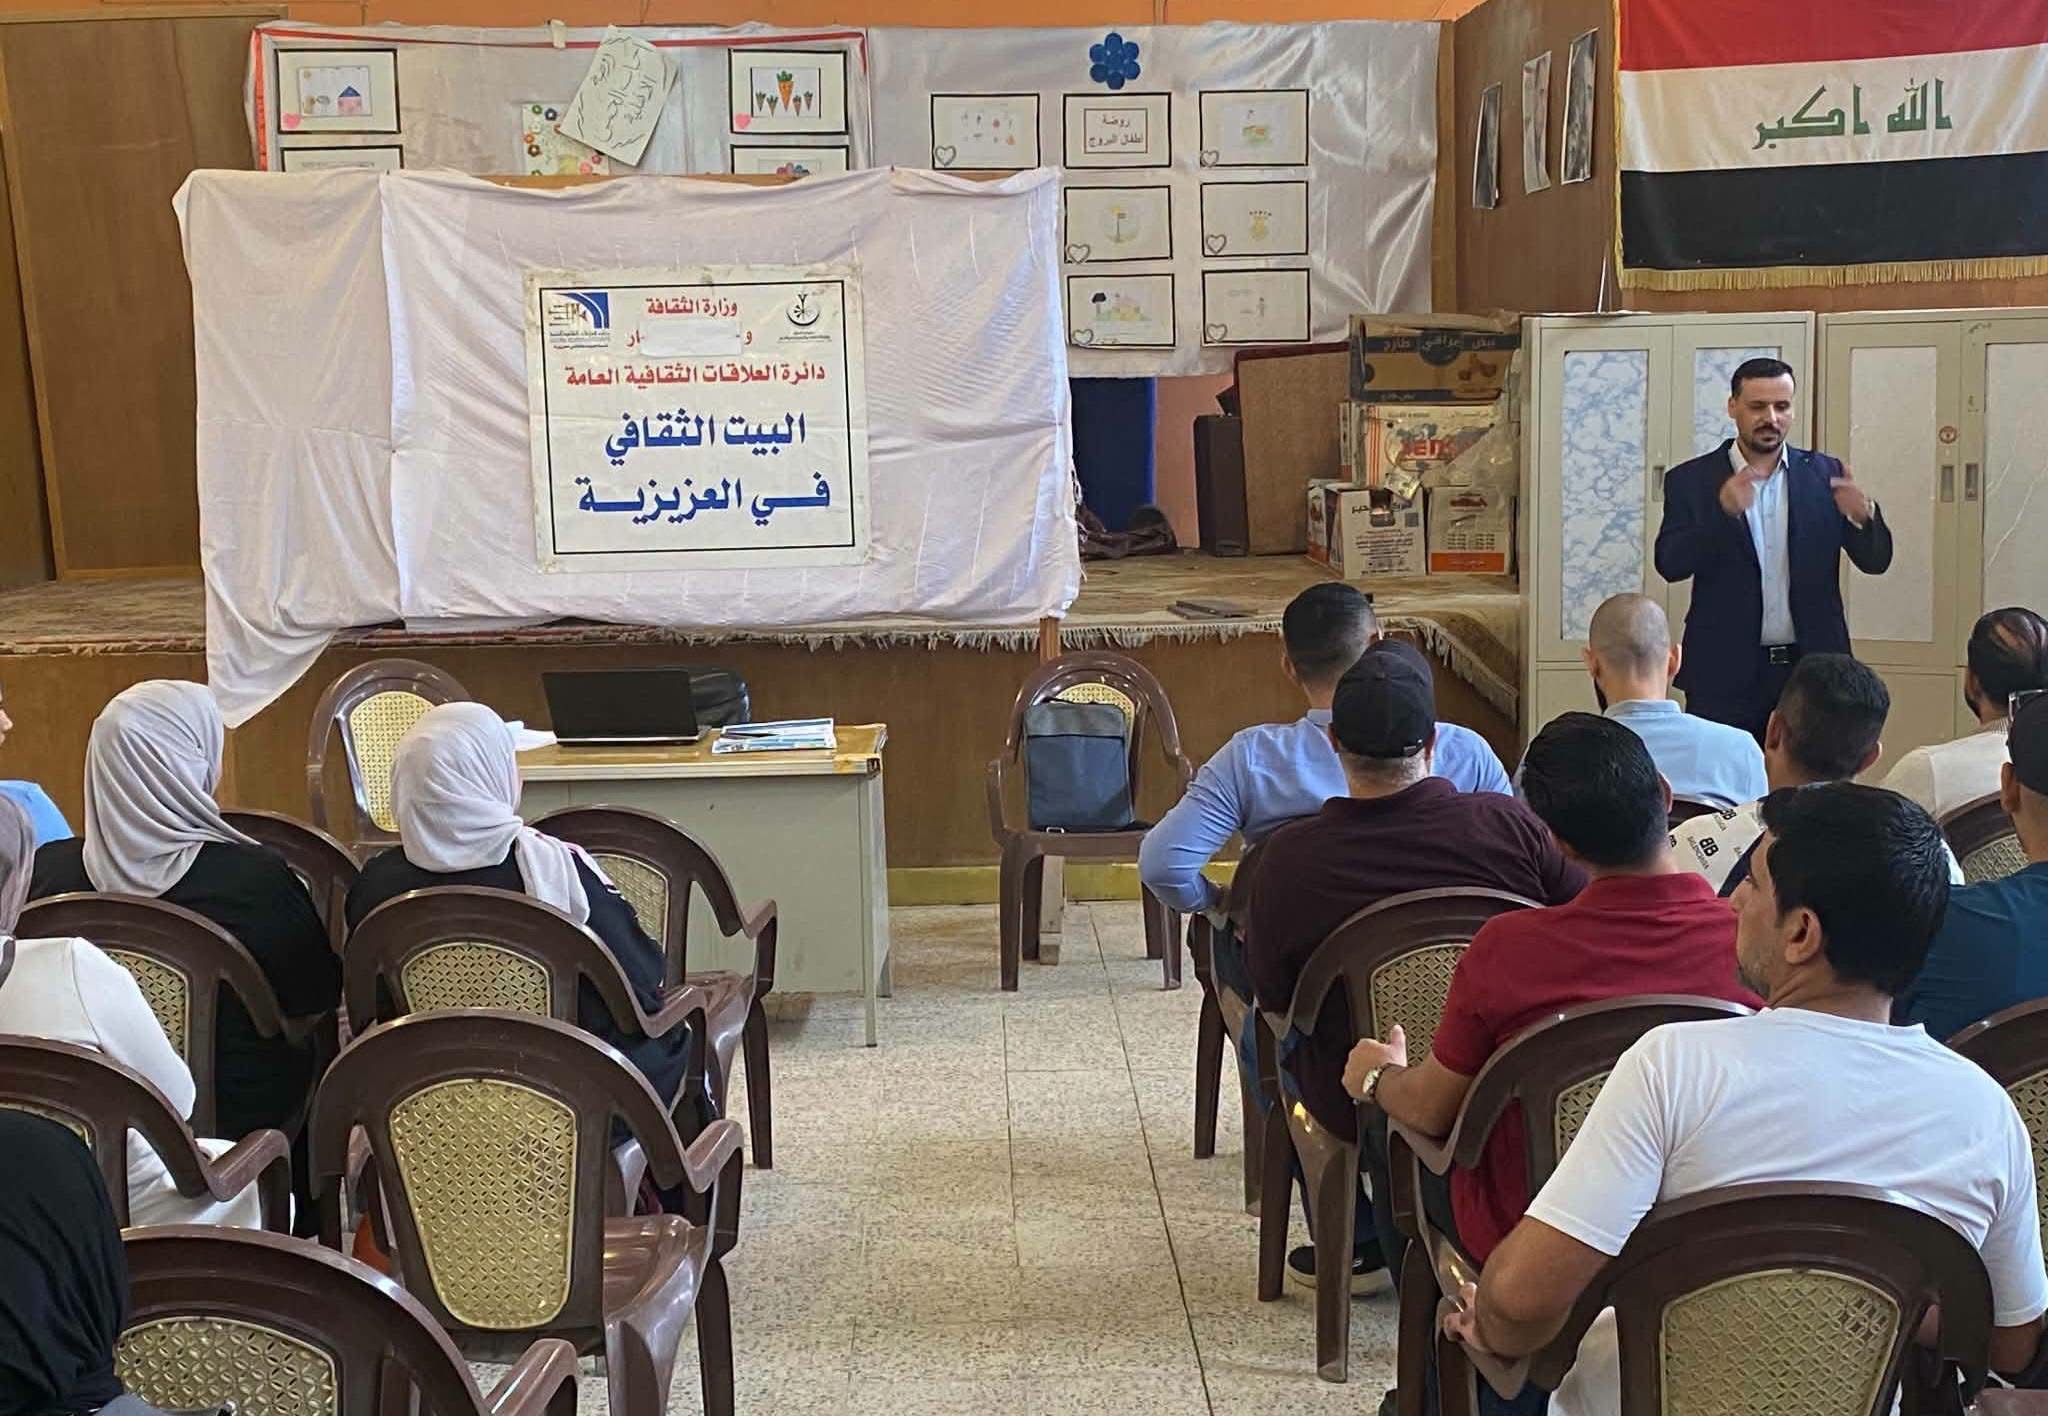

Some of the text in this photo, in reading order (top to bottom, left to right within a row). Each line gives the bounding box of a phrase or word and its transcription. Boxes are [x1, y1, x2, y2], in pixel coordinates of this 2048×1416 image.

[645, 297, 738, 315] وزارة الثقافة
[565, 362, 826, 390] دائرة العلاقات الثقافية العامة
[605, 408, 806, 466] البيت الثقافي
[574, 471, 832, 527] في العزيزية
